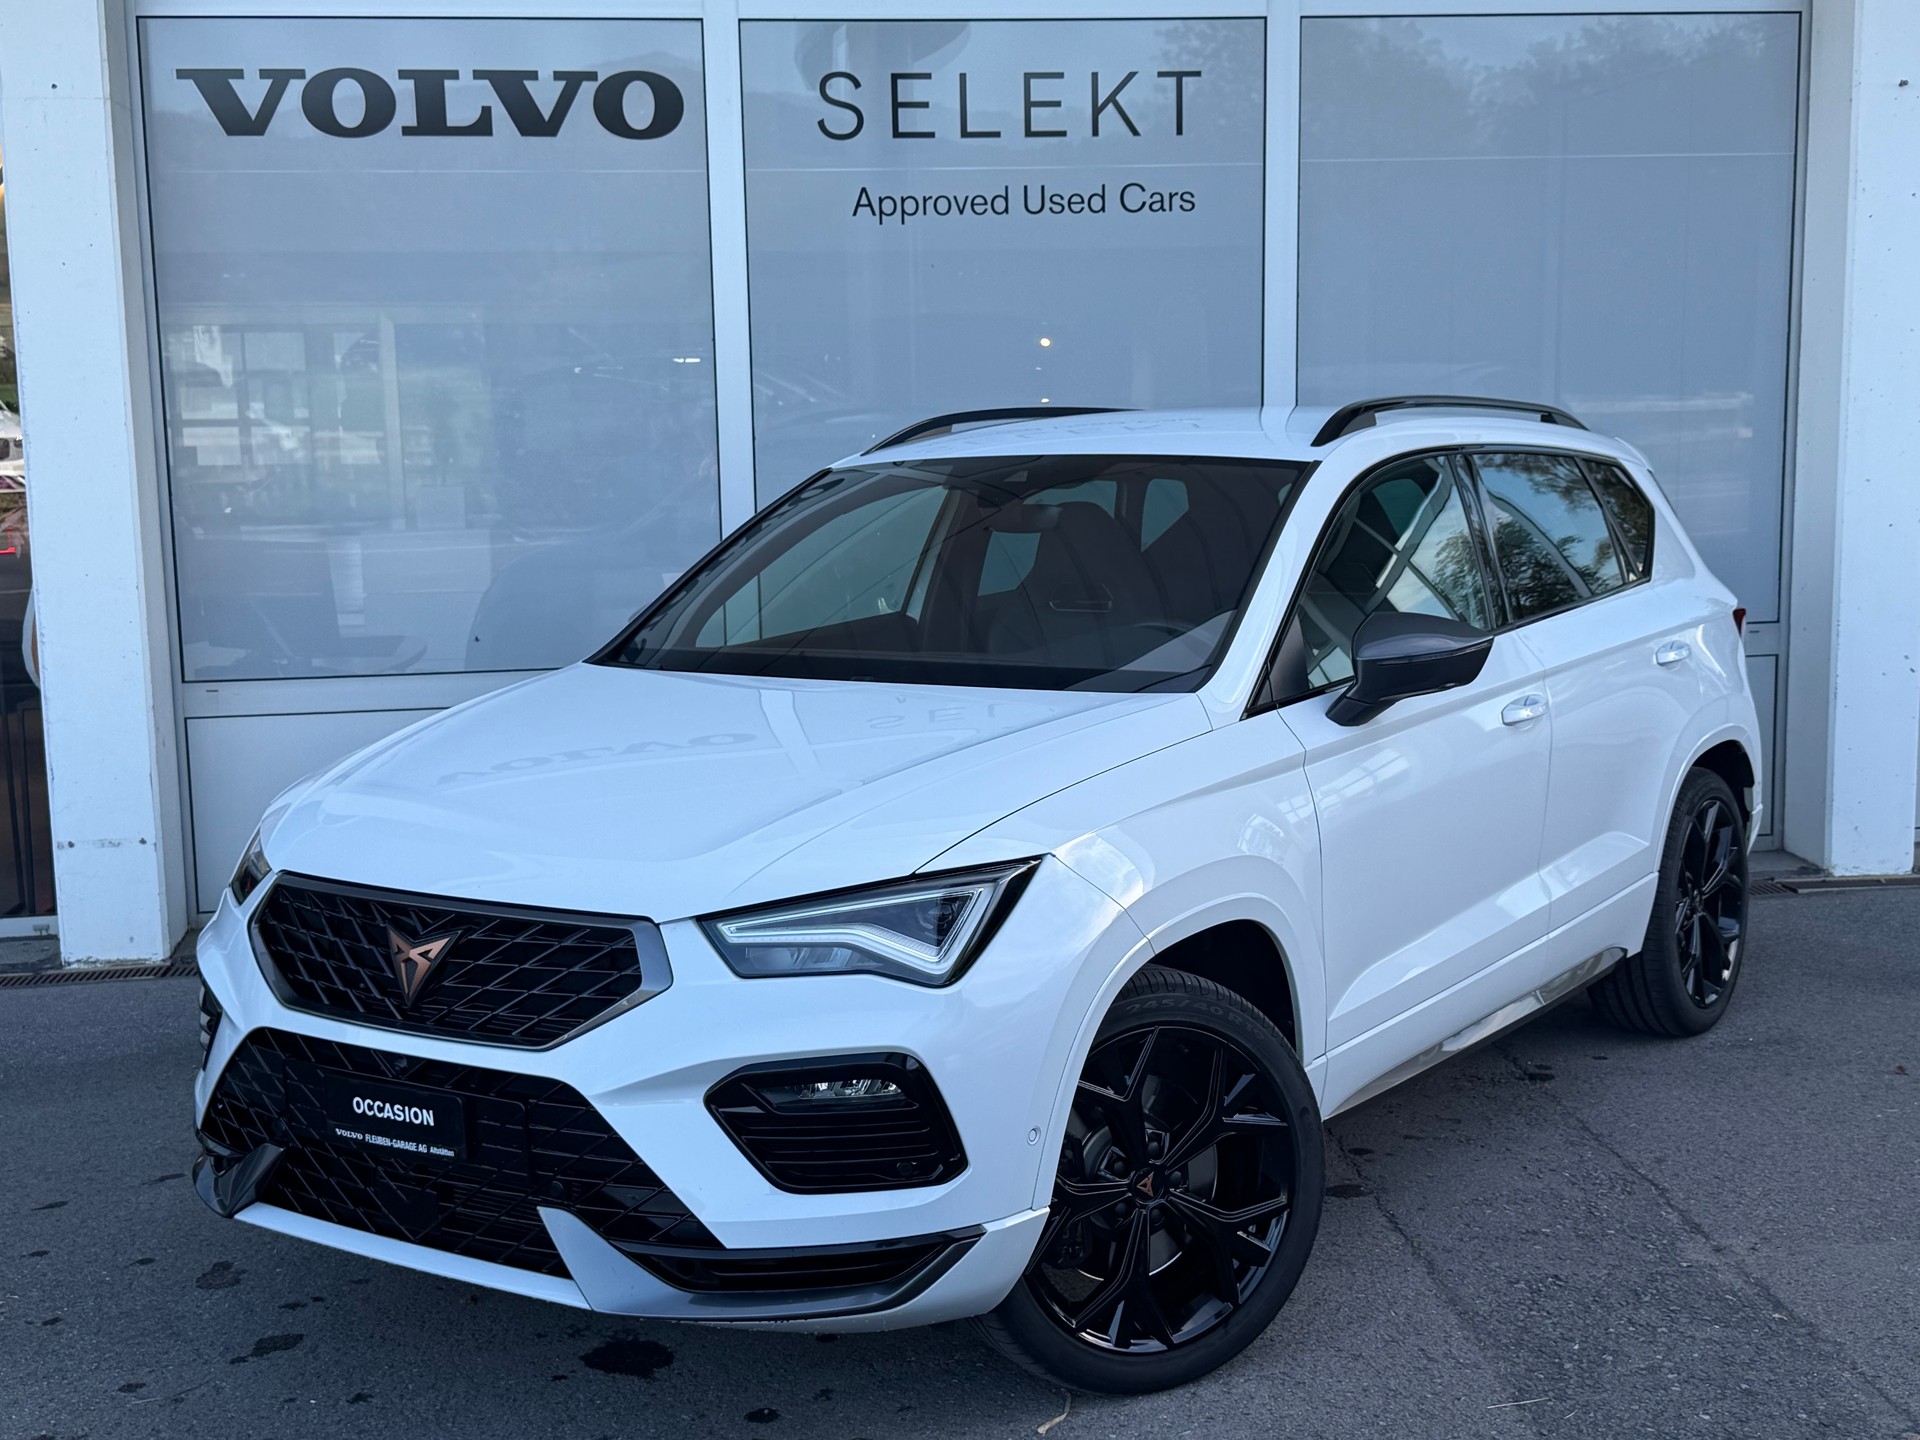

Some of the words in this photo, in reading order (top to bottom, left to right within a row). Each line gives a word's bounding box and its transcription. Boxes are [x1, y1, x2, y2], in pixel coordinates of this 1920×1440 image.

[176, 67, 685, 140] VOLVO
[817, 70, 1202, 141] SELEKT
[852, 185, 1010, 226] Approved
[1023, 184, 1106, 215] Used
[1119, 183, 1196, 214] Cars
[1126, 998, 1224, 1016] 245/40
[352, 1096, 435, 1126] OCCASION
[335, 1128, 363, 1140] VOLVO
[418, 1144, 428, 1153] AG
